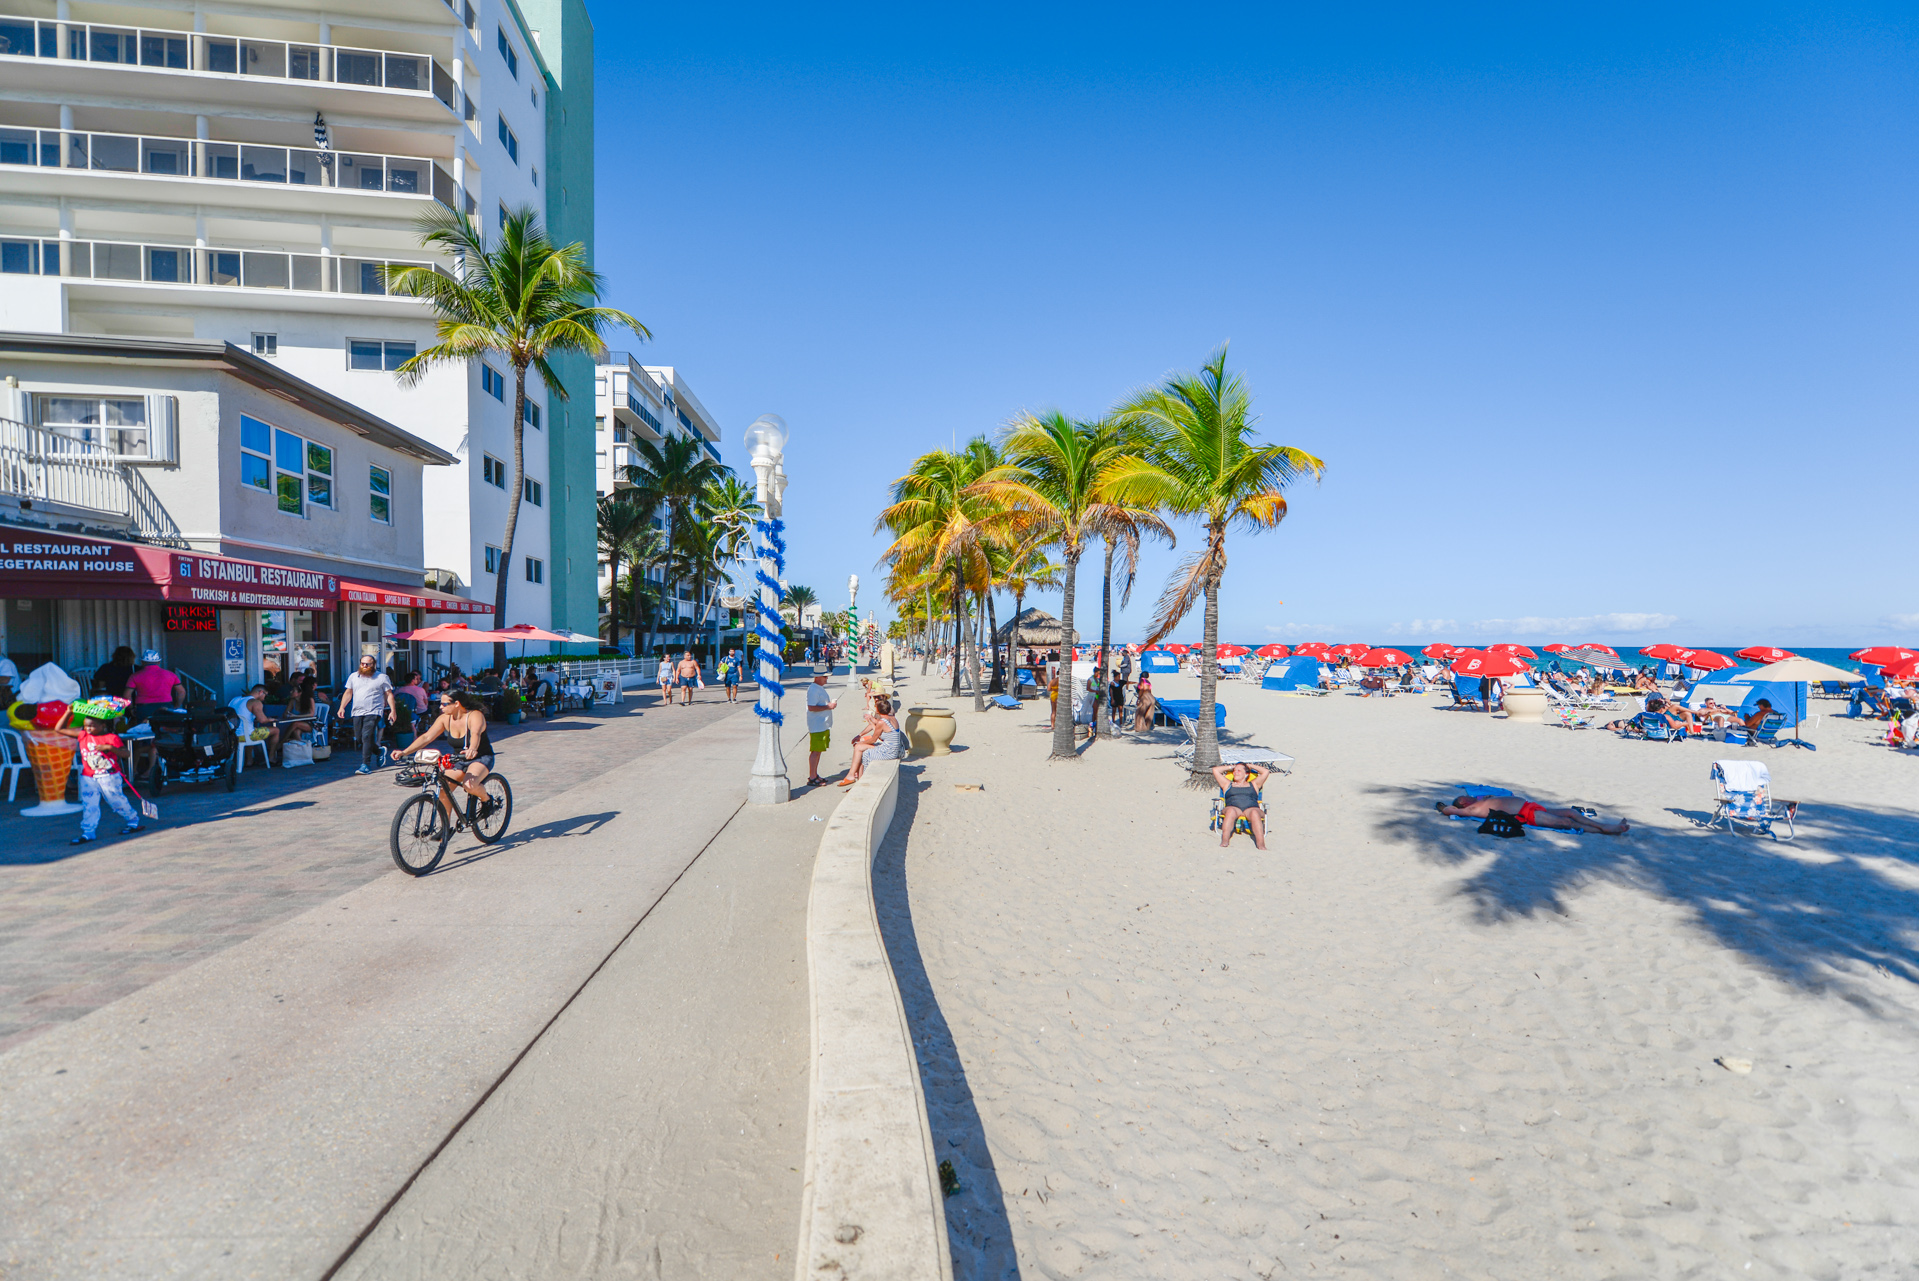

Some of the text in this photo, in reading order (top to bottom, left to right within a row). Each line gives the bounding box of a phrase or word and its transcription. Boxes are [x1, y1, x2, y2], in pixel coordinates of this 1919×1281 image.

[13, 543, 112, 556] RESTAURANT
[84, 561, 134, 572] HOUSE
[180, 562, 192, 578] 61
[198, 559, 324, 590] ISTANBUL RESTAURANT
[191, 588, 324, 608] TURKISH & MEDITERRANEAN CUISINE
[348, 590, 361, 600] CUCINA
[167, 605, 216, 618] TURKISH
[166, 619, 217, 631] CUISINE
